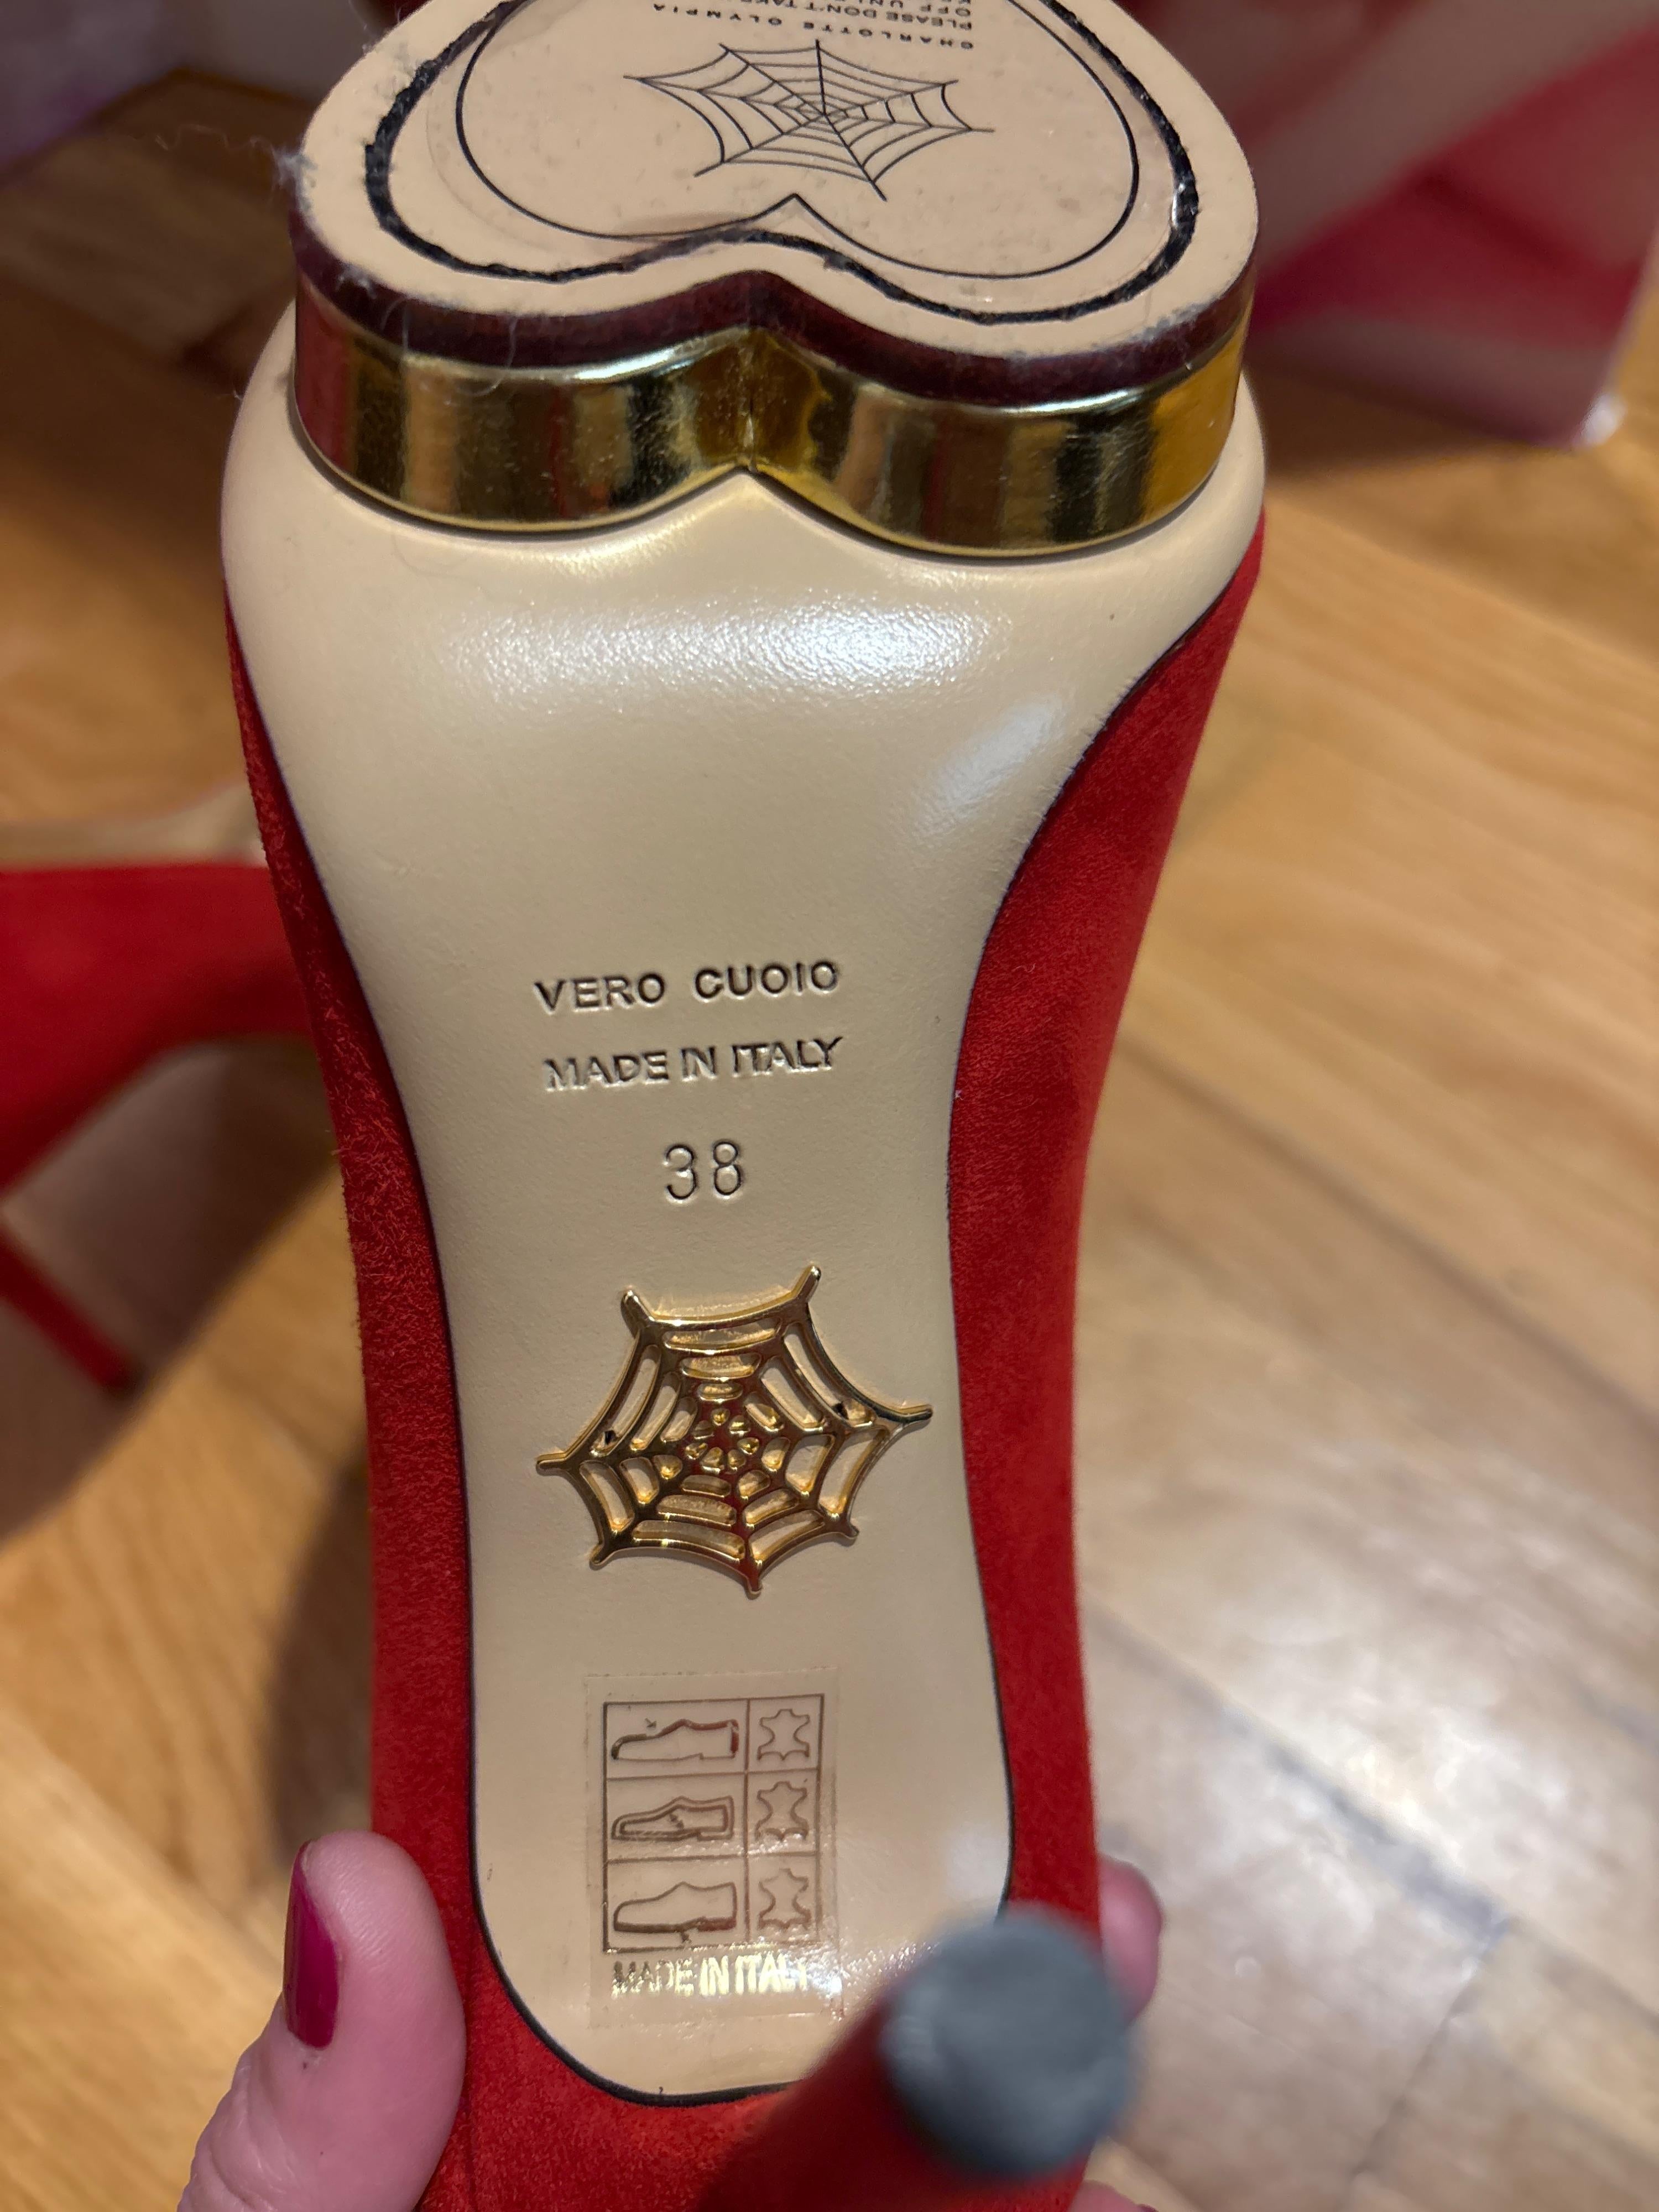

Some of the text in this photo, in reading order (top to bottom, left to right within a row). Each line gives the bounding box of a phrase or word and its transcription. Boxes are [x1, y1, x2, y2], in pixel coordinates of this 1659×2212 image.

[653, 3, 973, 50] CHARLOTTE OLYMPIA
[886, 12, 972, 30] PLEASE
[534, 959, 839, 1014] VERO CUOIO
[544, 1036, 843, 1092] MADE IN ITALY
[664, 1140, 744, 1203] 38
[611, 1960, 695, 1999] MADE
[698, 1954, 730, 1996] IN
